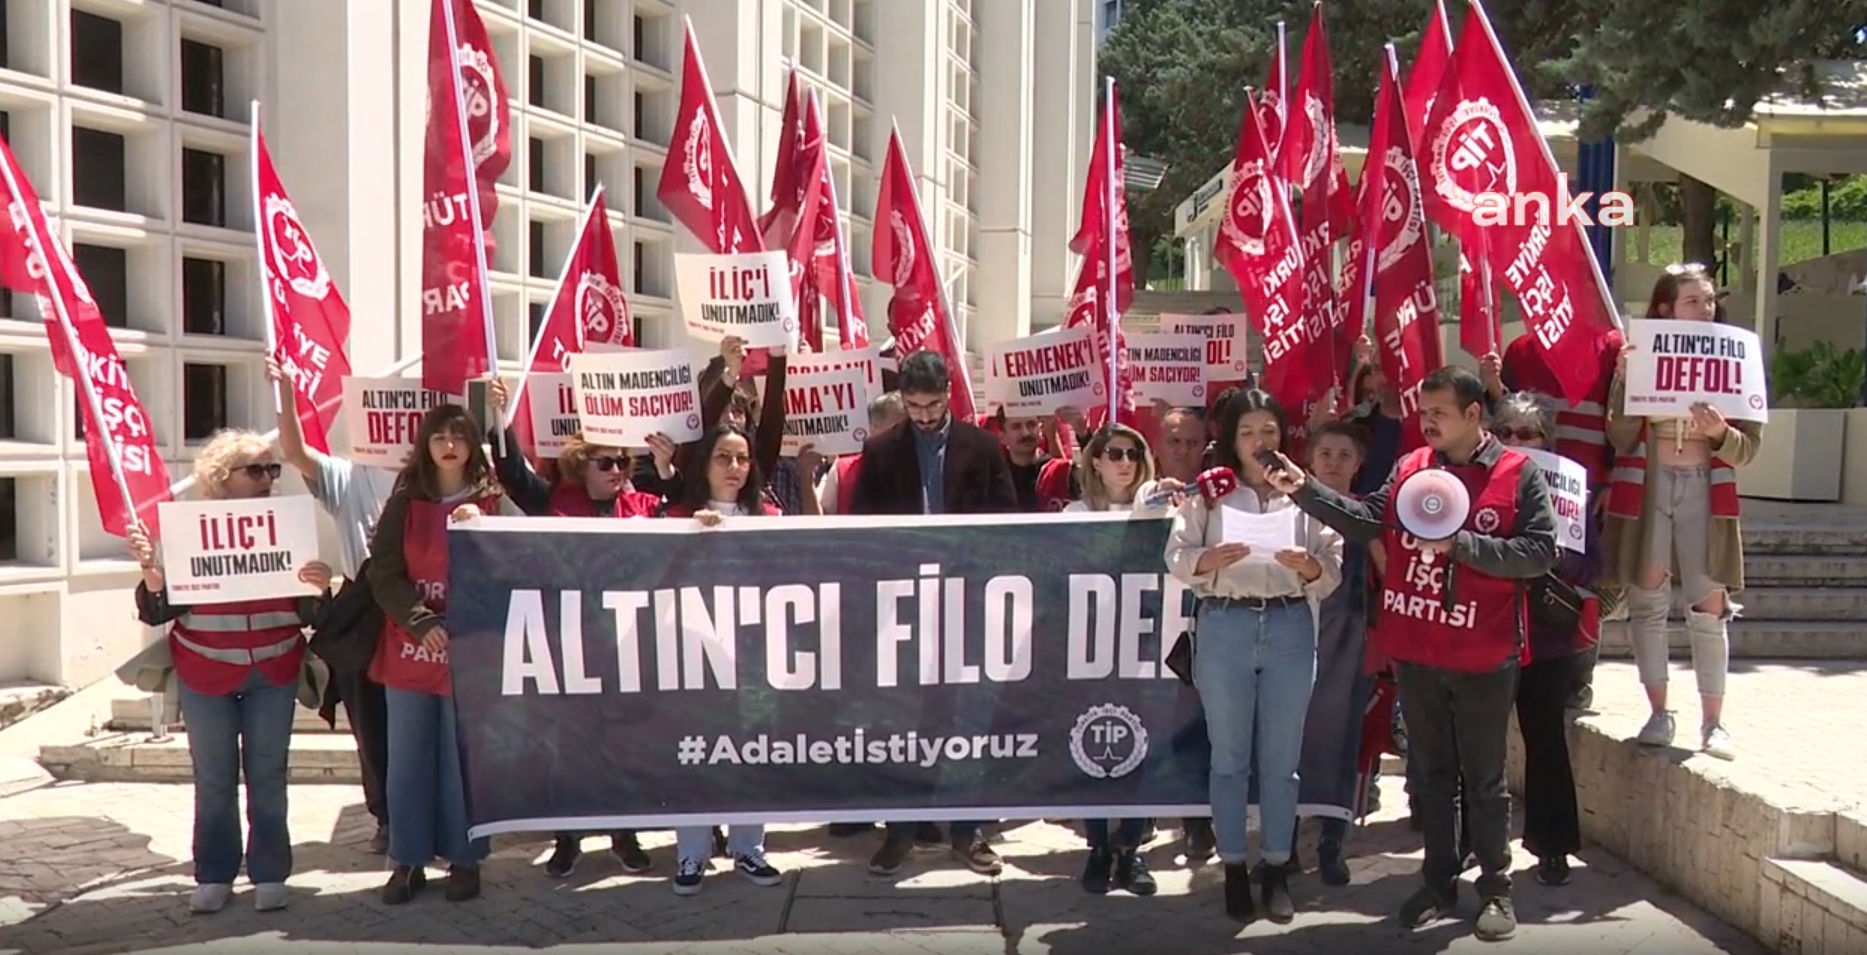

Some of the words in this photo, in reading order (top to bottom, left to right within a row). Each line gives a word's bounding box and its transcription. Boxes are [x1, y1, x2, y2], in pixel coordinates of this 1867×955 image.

[708, 264, 770, 302] İLİÇ'İ
[701, 302, 780, 325] UNUTMADIK!
[1005, 335, 1094, 379] ERMENEK'İ
[1127, 347, 1142, 362] TIN
[1206, 340, 1231, 365] OL!
[1652, 333, 1715, 355] ALTIN'CI
[1720, 335, 1746, 360] FİLO
[581, 371, 615, 391] ALTIN
[1019, 370, 1091, 398] UNUTMADIK!
[1655, 356, 1742, 395] DEFOL!
[362, 389, 416, 409] ALTIN'CI
[584, 393, 624, 417] ÖLÜM
[629, 390, 694, 418] SAÇIYOR!
[784, 382, 856, 415] MA'YI
[367, 411, 423, 445] DEFO
[199, 510, 277, 550] İLİÇ'İ
[190, 551, 292, 578] UNUTMADIK!
[1384, 589, 1477, 629] PARTİSİ
[501, 582, 841, 696] ALTIN'CI
[876, 563, 1034, 687] FİLO
[1067, 572, 1196, 679] DEF
[1090, 720, 1129, 744] TİP
